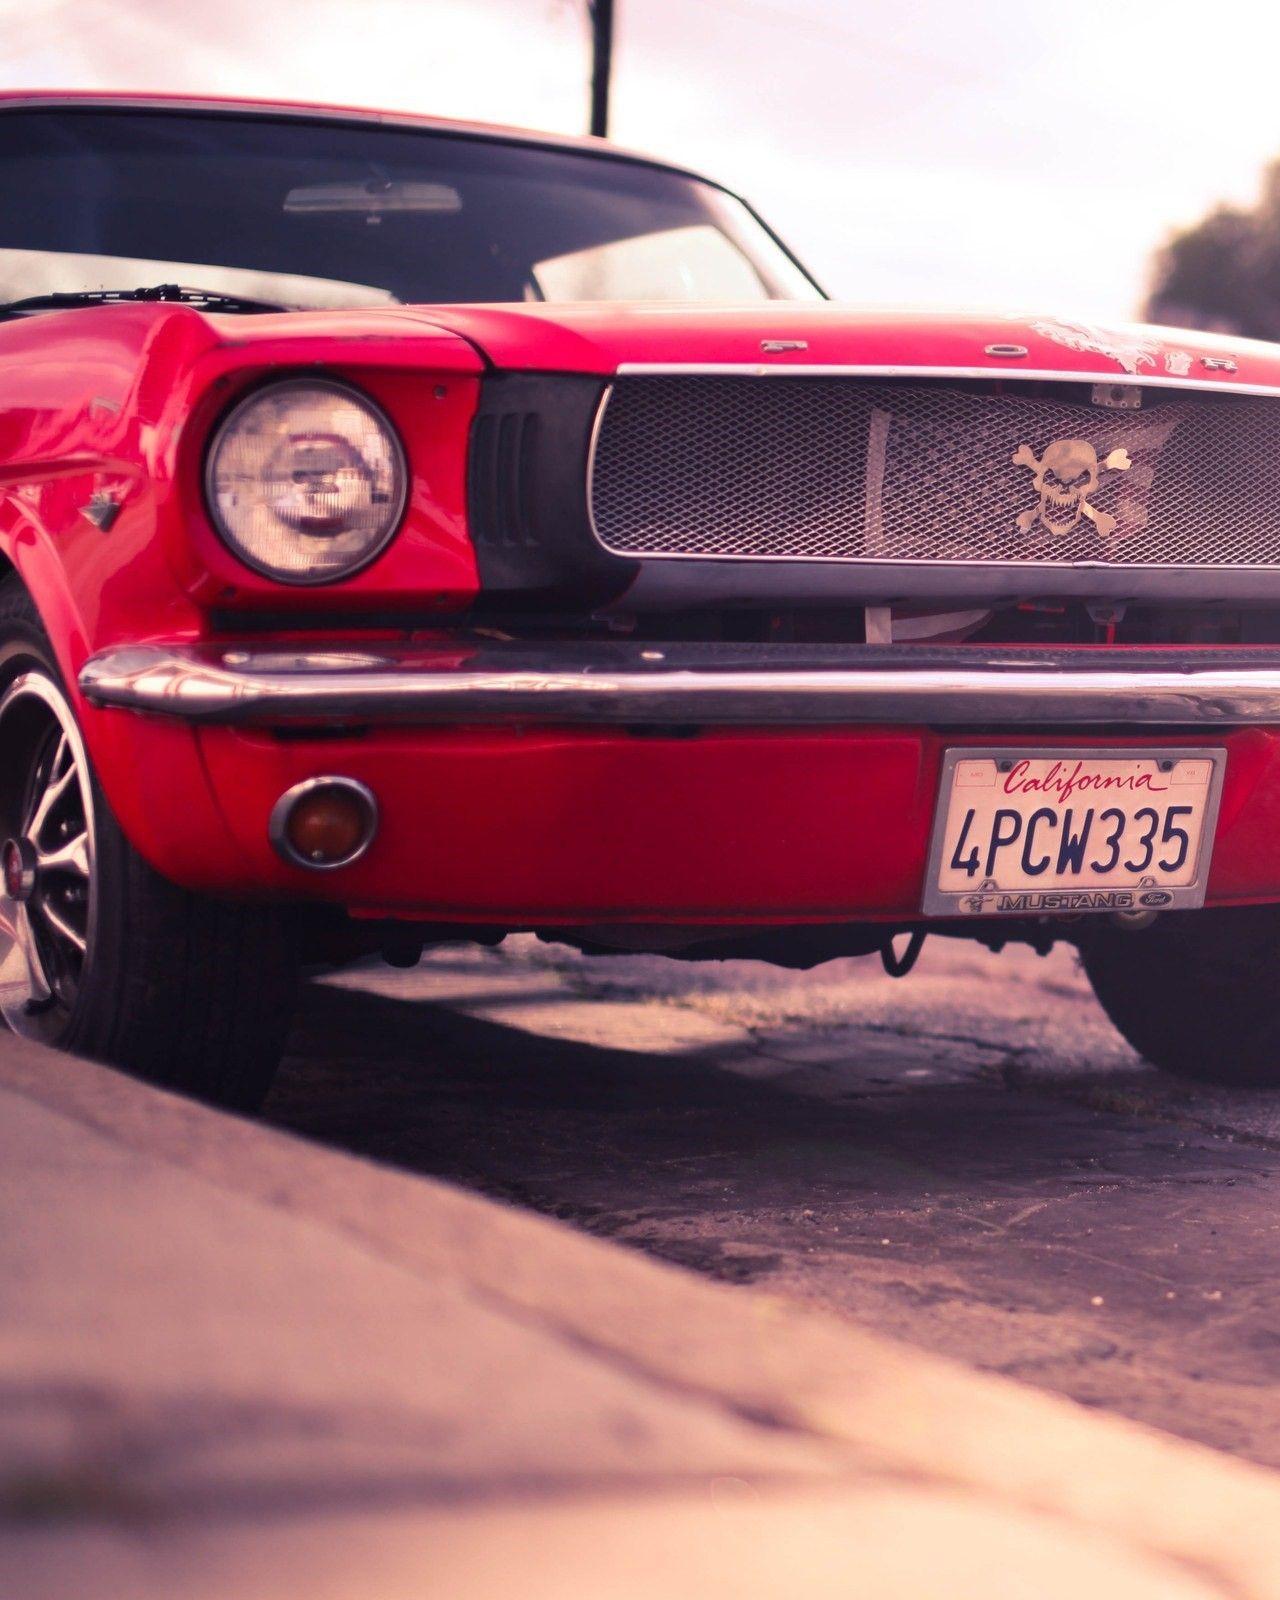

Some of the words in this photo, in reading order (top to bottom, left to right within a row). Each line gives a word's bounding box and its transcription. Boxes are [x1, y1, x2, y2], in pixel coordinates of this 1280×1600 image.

[1003, 760, 1167, 804] California
[950, 806, 1193, 877] 4PCW335
[998, 893, 1133, 911] MUSTANG
